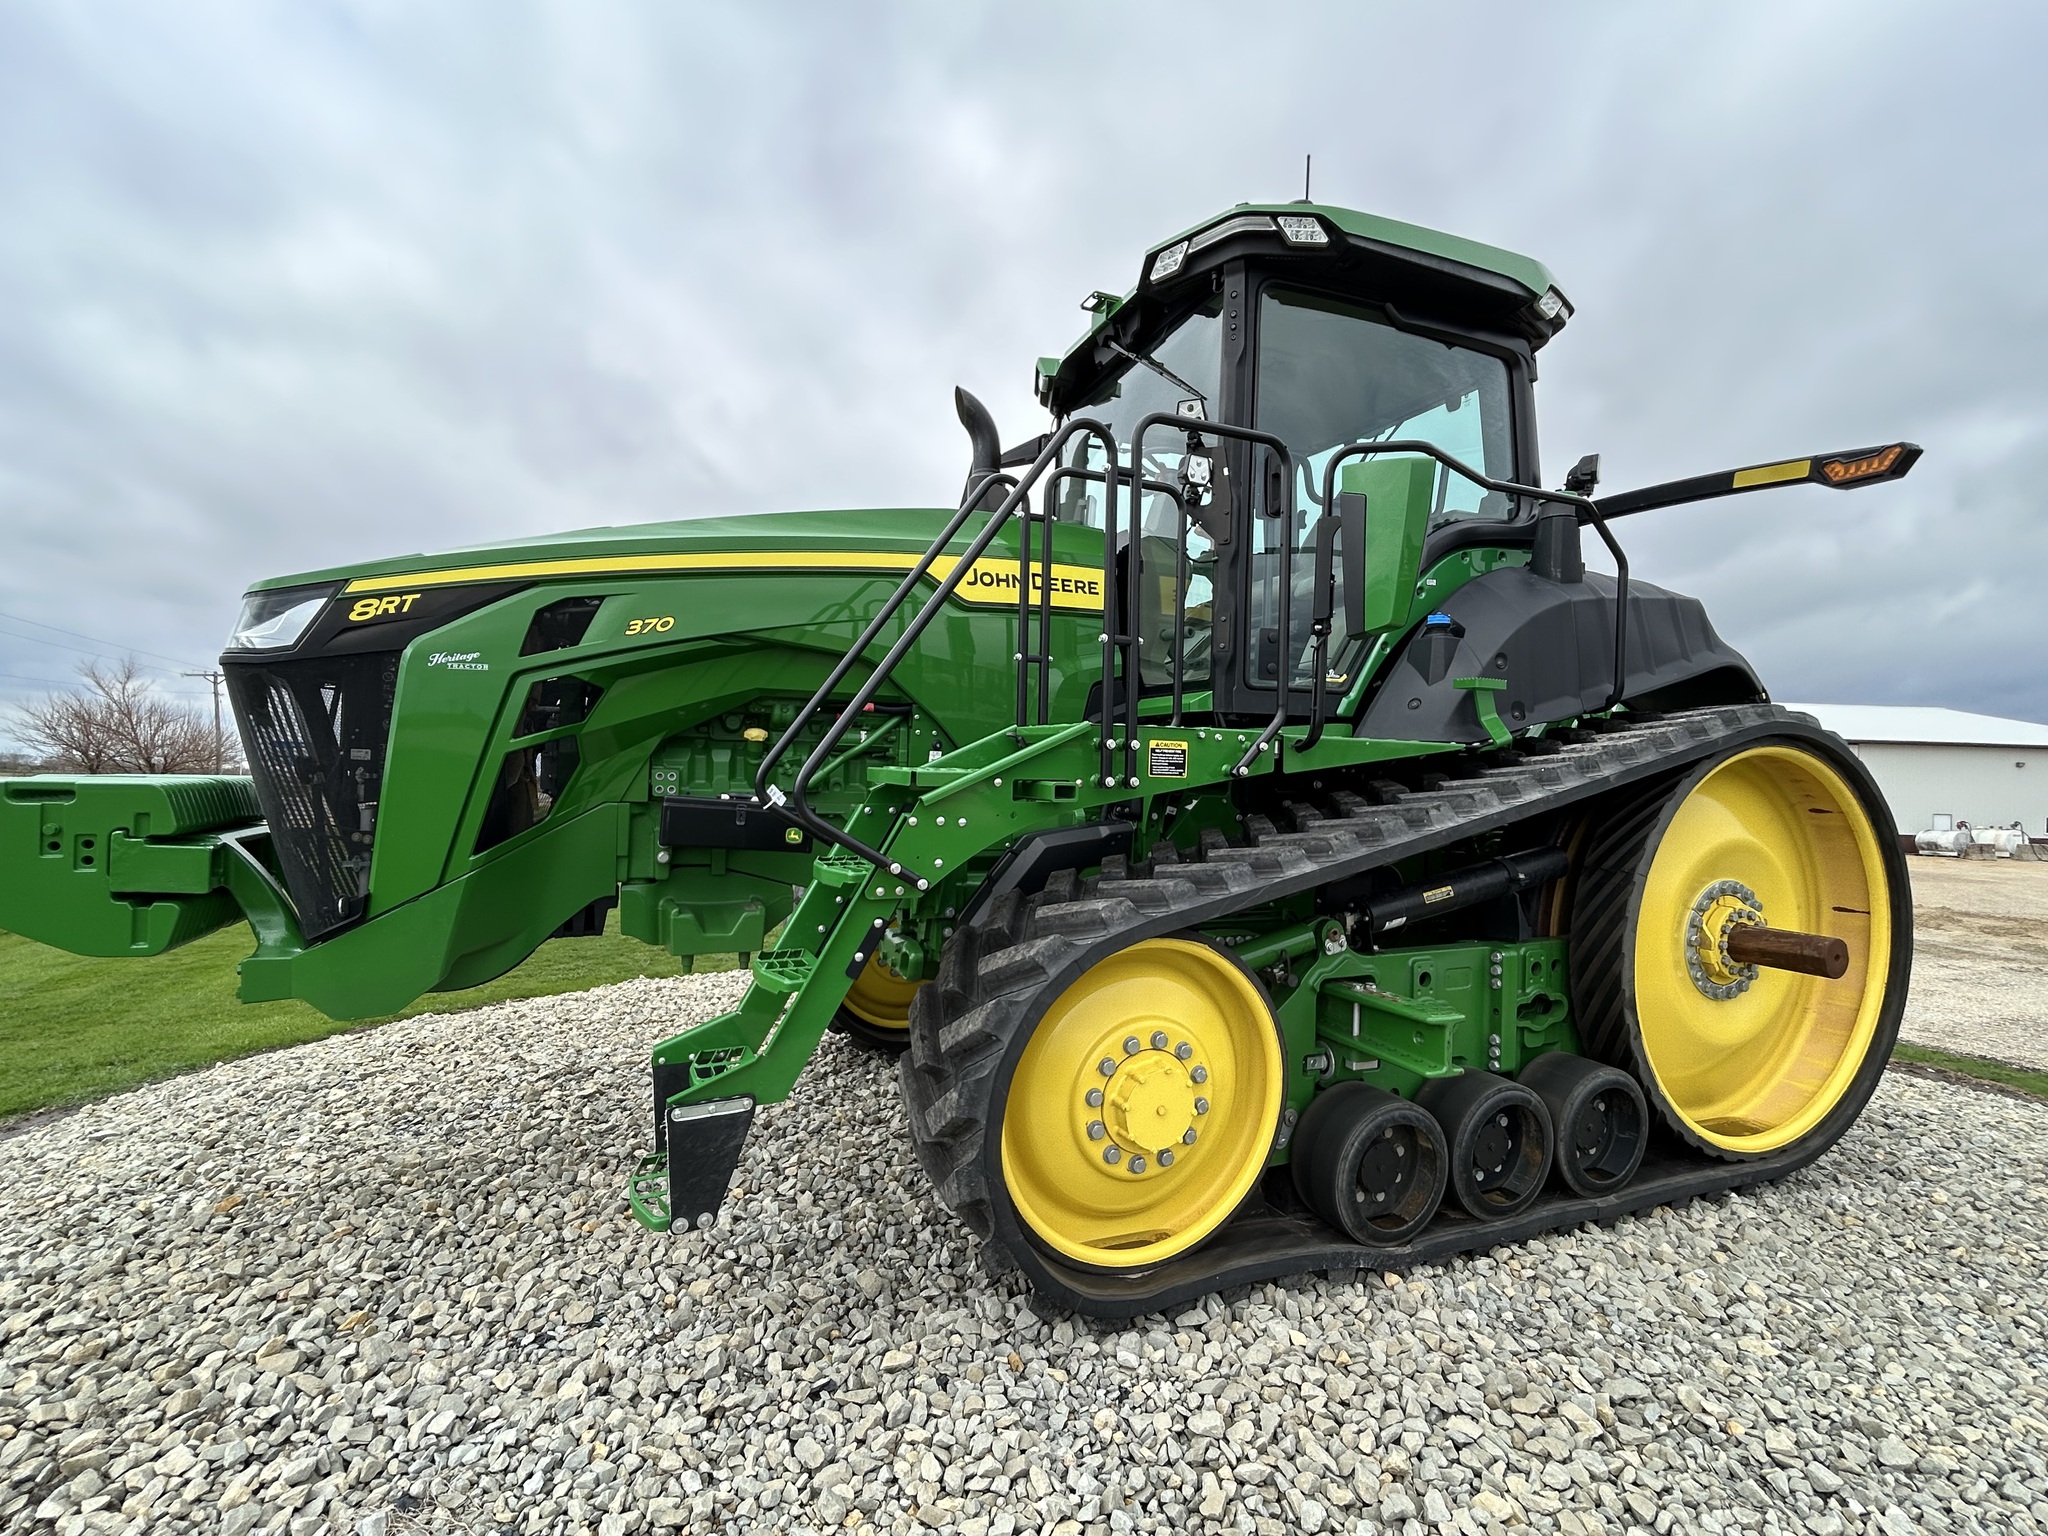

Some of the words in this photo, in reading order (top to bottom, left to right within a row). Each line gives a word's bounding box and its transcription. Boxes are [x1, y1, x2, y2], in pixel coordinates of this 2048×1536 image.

[967, 569, 1021, 588] JOHN
[1031, 573, 1099, 594] DEERE
[348, 593, 421, 621] 8RT
[624, 616, 675, 636] 370
[427, 651, 481, 668] Heritage
[447, 663, 489, 671] TRACTOR
